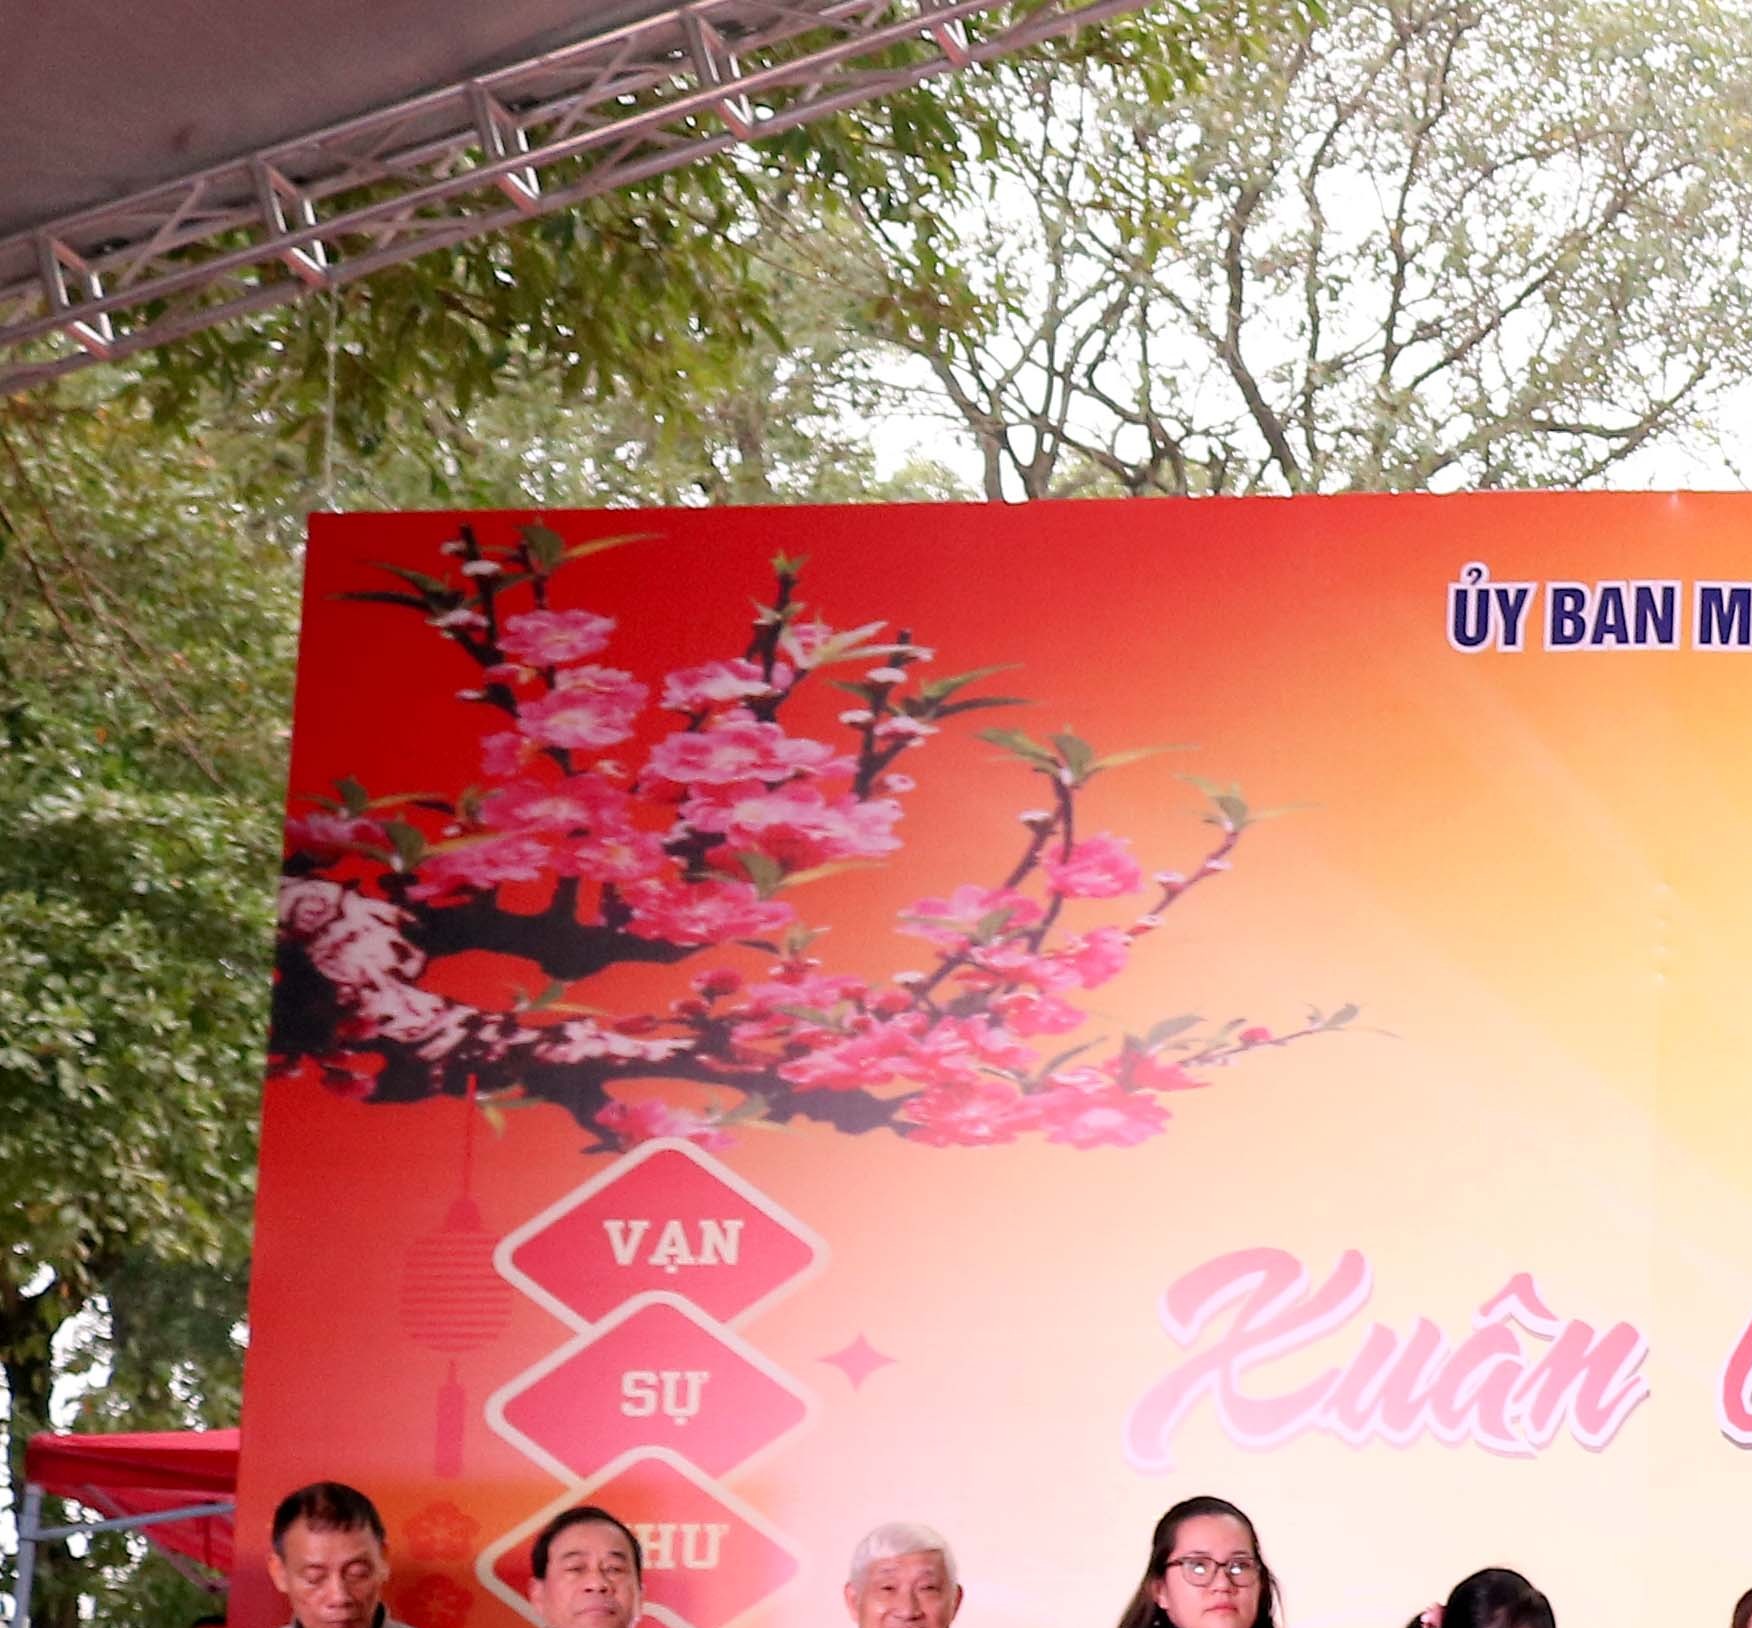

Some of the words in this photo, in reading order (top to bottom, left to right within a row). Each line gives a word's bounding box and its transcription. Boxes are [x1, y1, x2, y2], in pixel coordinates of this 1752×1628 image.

[1452, 567, 1529, 647] ỦY
[1551, 586, 1675, 646] BAN
[603, 1219, 744, 1273] VẠN
[619, 1370, 711, 1425] SỰ
